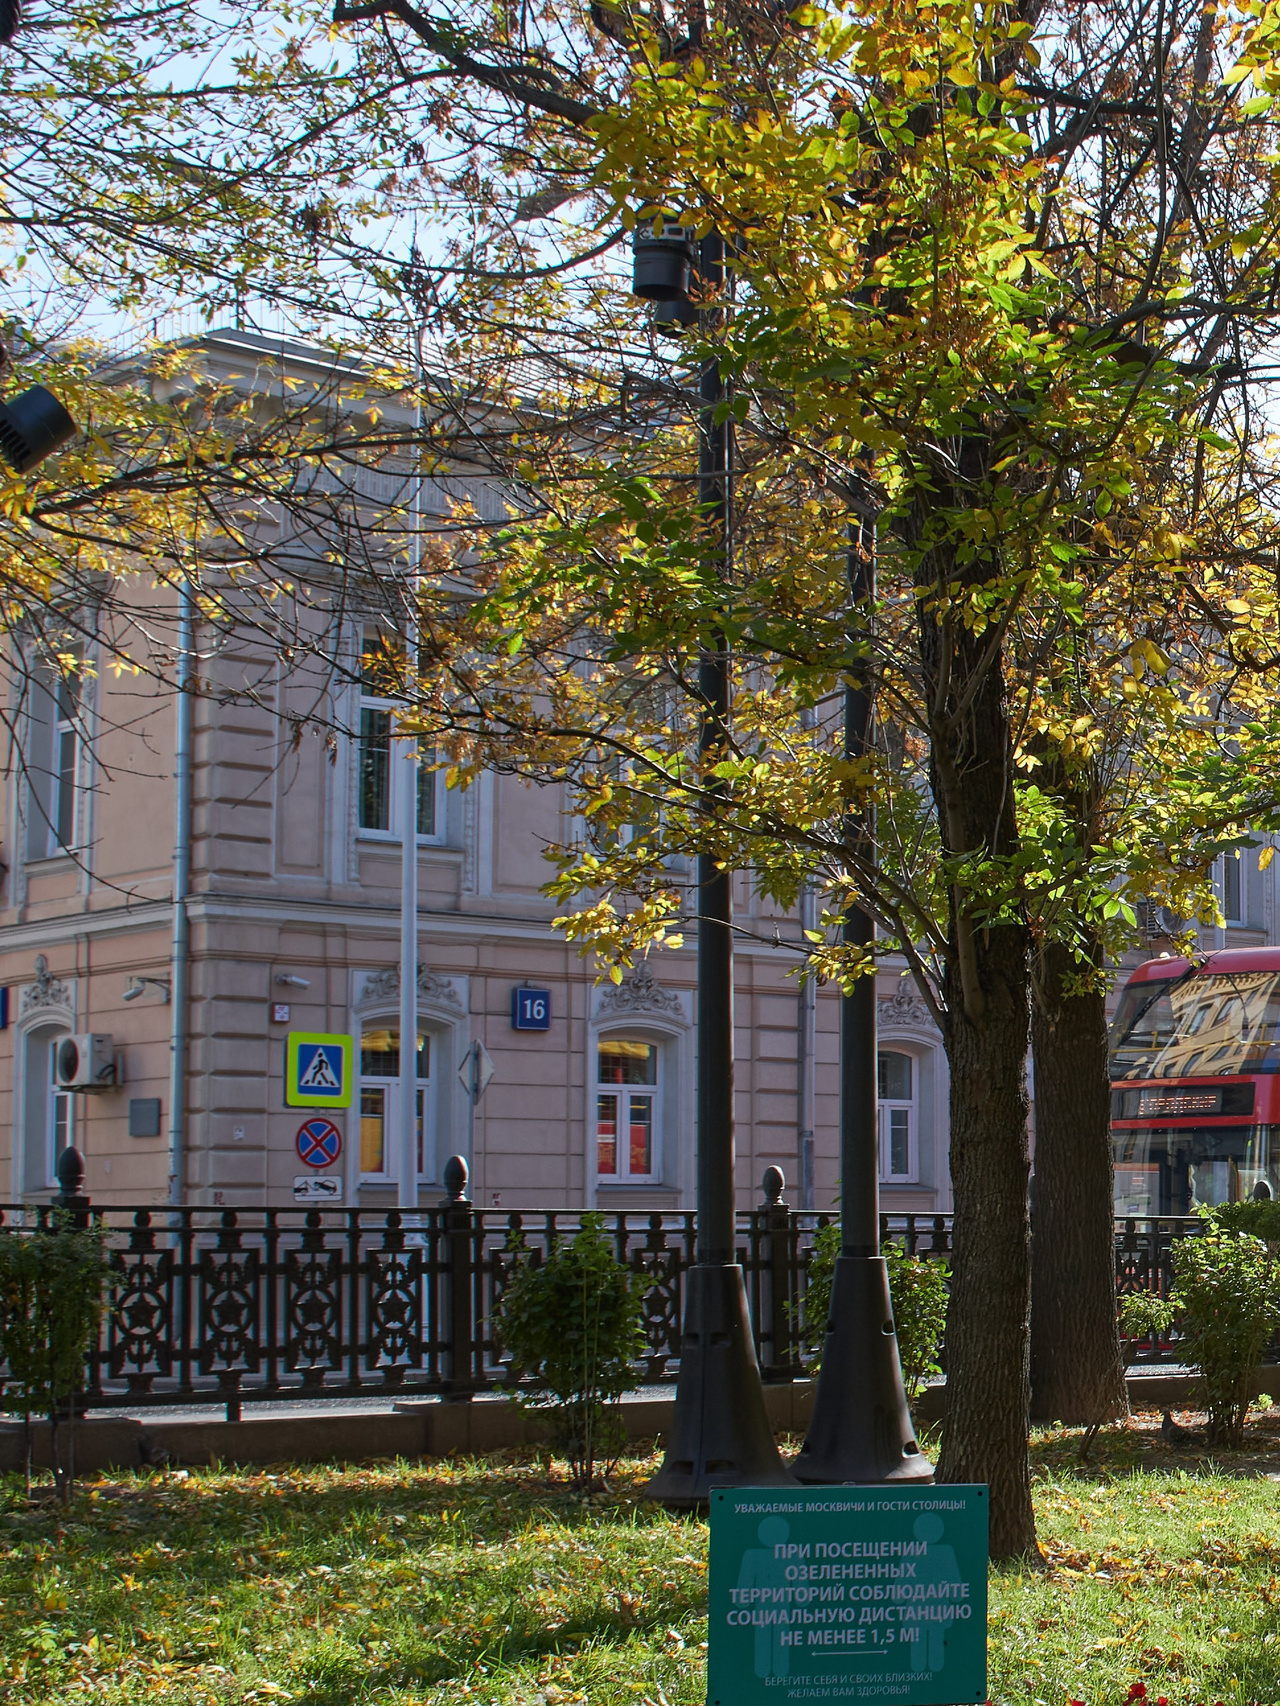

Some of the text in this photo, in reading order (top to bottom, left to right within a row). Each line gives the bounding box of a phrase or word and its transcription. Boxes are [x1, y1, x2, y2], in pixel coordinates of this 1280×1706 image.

[524, 999, 546, 1020] 16
[734, 1499, 966, 1514] УВАЖАЕМЫЕ МОСКВИЧИ И ГОСТИ СТОЛИЦЫ!
[774, 1541, 928, 1560] ПРИ ПОСЕЩЕНИИ
[784, 1562, 917, 1581] ОЗЕЛЕНЕННЫХ
[729, 1581, 970, 1604] ТЕРРИТОРИЙ СОБЛЮДАЙТЕ
[726, 1604, 972, 1628] СОЦИАЛЬНУЮ ДИСТАНЦИЮ
[780, 1627, 920, 1646] НЕ МЕНЕЕ 1,5 М!
[764, 1671, 933, 1687] БЕРЕГИТЕ СЕБЯ И СВОИХ БЛИЗКИХ!
[787, 1685, 911, 1698] ЖЕЛАЕМ ВАМ ЗДОРОВЬЯ!
